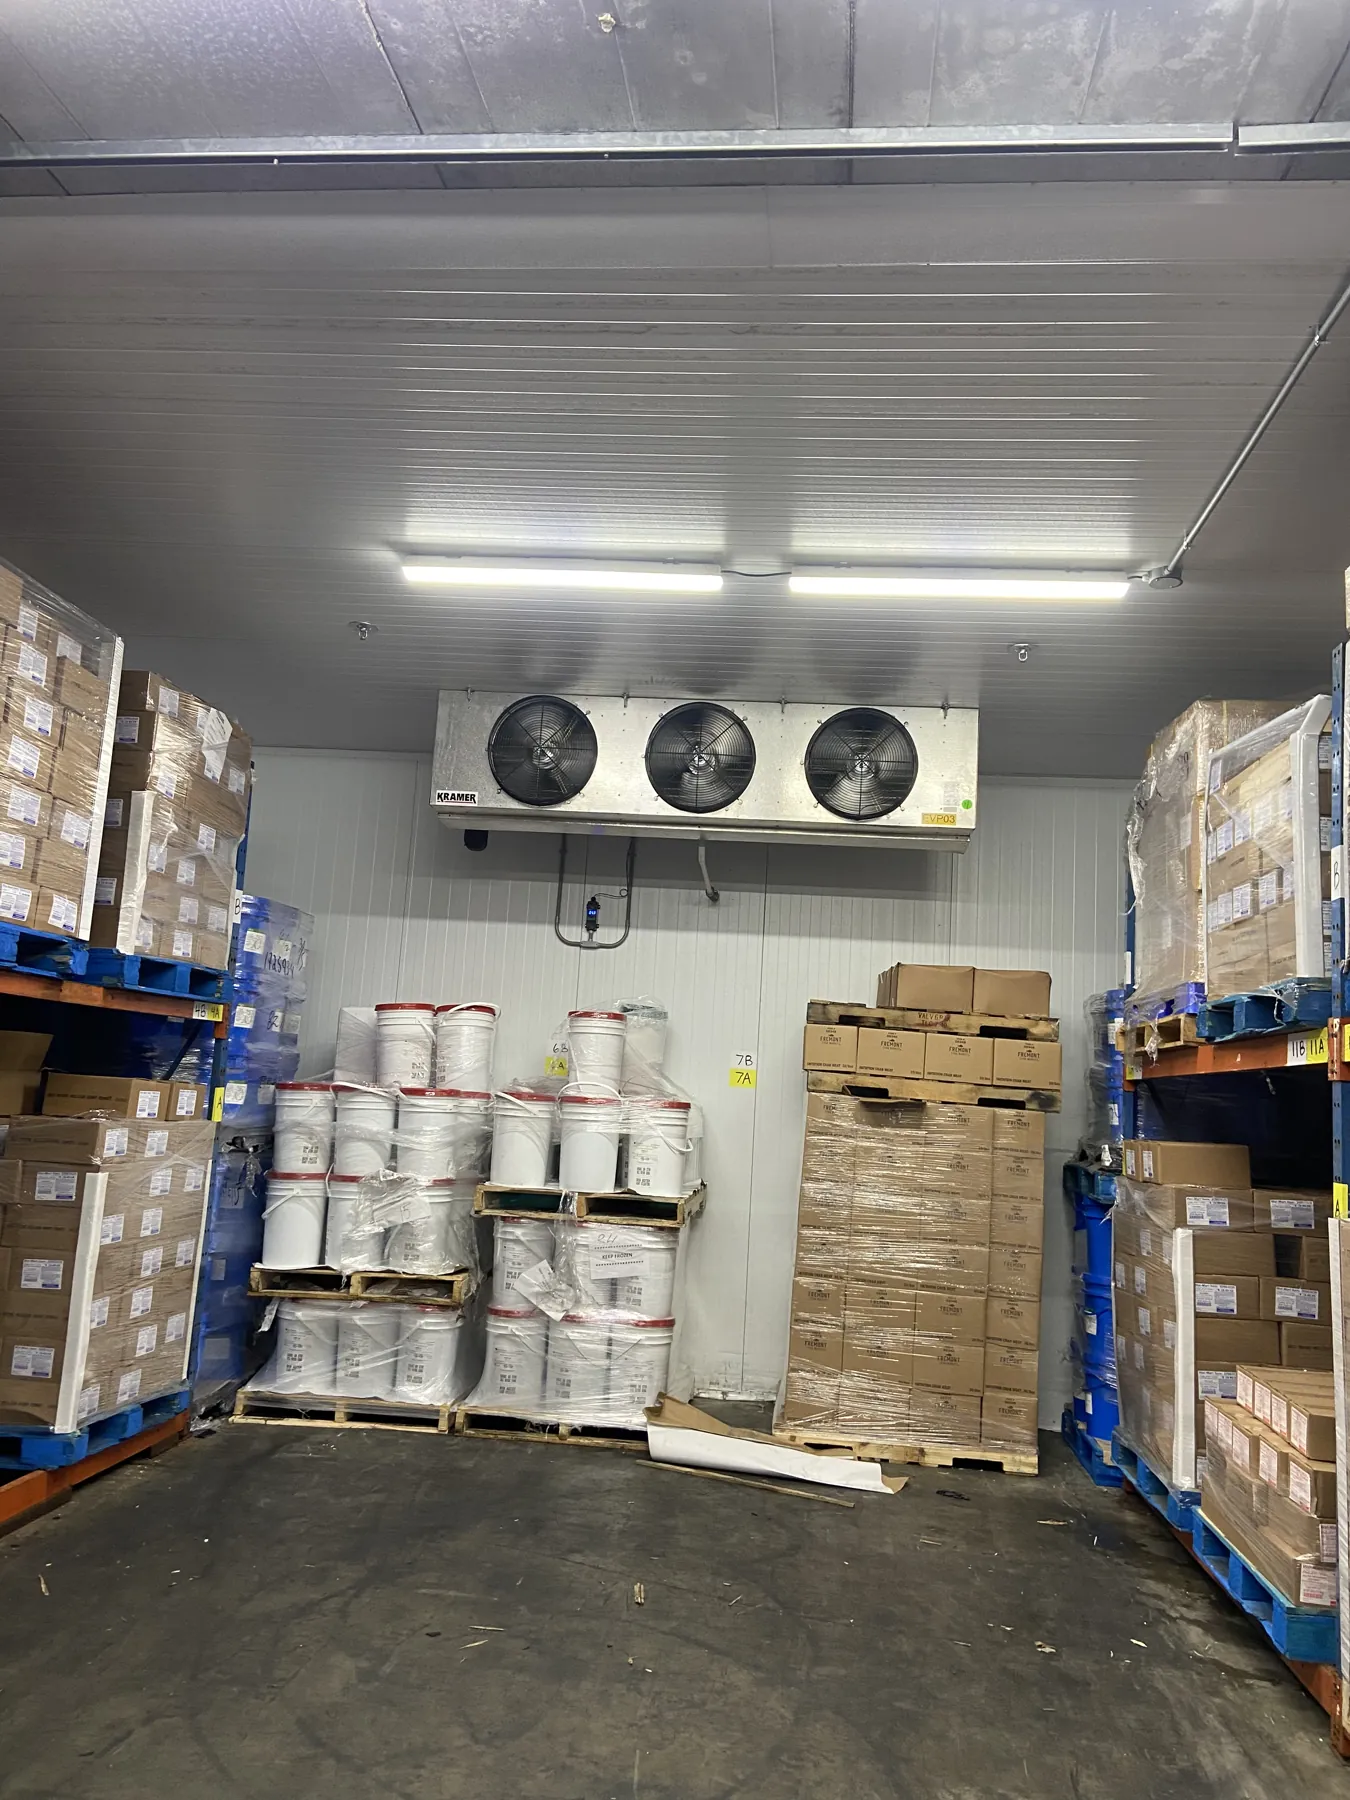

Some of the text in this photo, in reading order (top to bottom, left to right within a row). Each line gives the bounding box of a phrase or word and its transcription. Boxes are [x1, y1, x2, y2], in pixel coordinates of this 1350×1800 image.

[437, 792, 477, 804] KRAMER
[210, 1005, 221, 1020] 4A
[552, 1043, 569, 1053] 6B
[949, 1046, 971, 1054] FREMONT
[735, 1053, 754, 1066] 7B
[735, 1071, 752, 1084] 7A
[804, 1340, 827, 1348] FREMONT
